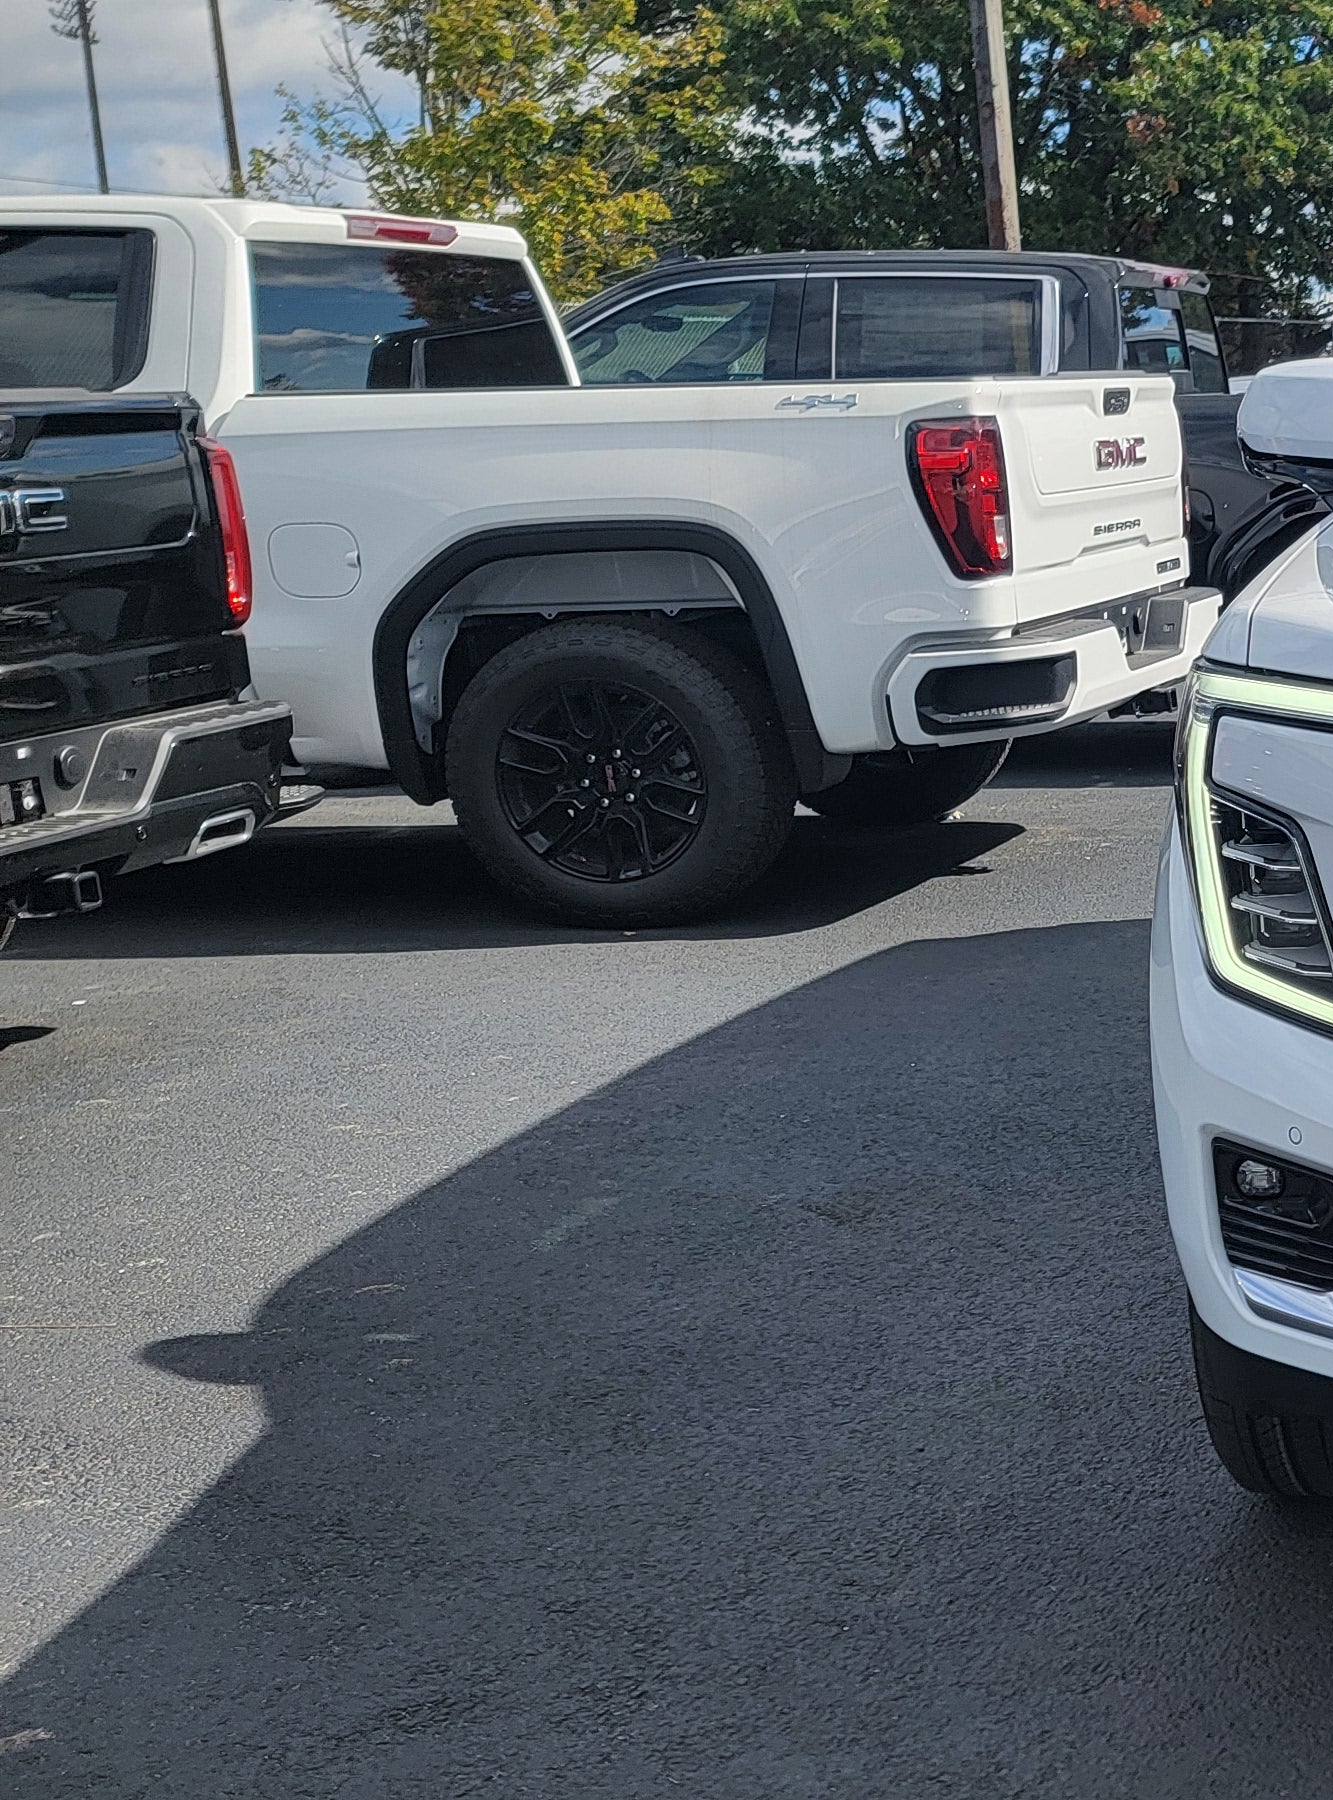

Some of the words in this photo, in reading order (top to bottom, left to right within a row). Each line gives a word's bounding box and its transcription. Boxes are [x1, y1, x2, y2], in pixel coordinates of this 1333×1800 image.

[1095, 437, 1147, 471] GMC
[0, 487, 68, 534] C
[1093, 518, 1141, 536] SIERRA
